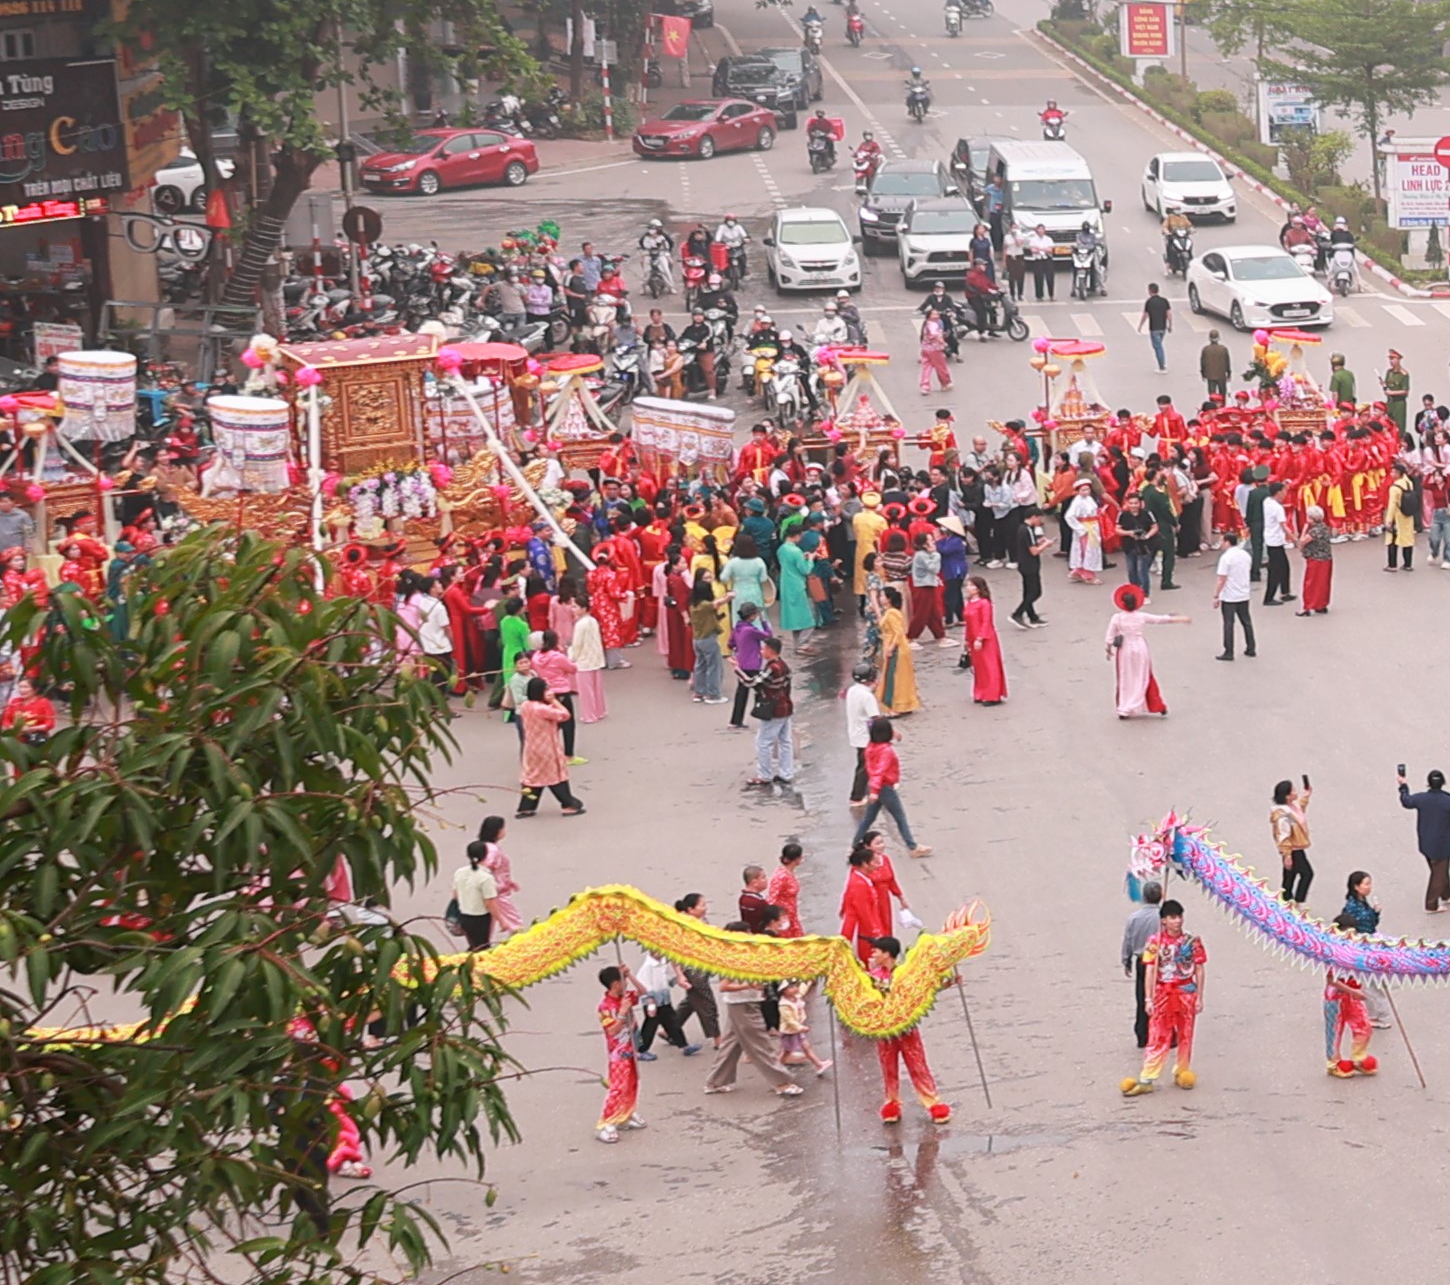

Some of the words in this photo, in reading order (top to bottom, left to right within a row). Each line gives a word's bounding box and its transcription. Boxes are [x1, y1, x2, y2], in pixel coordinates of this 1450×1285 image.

[7, 73, 54, 95] Tùng
[2, 98, 45, 111] DESIGN
[1411, 164, 1441, 176] HEAD
[24, 179, 50, 197] TRÊN
[73, 171, 99, 191] CHẤT
[1402, 179, 1423, 192] LINH
